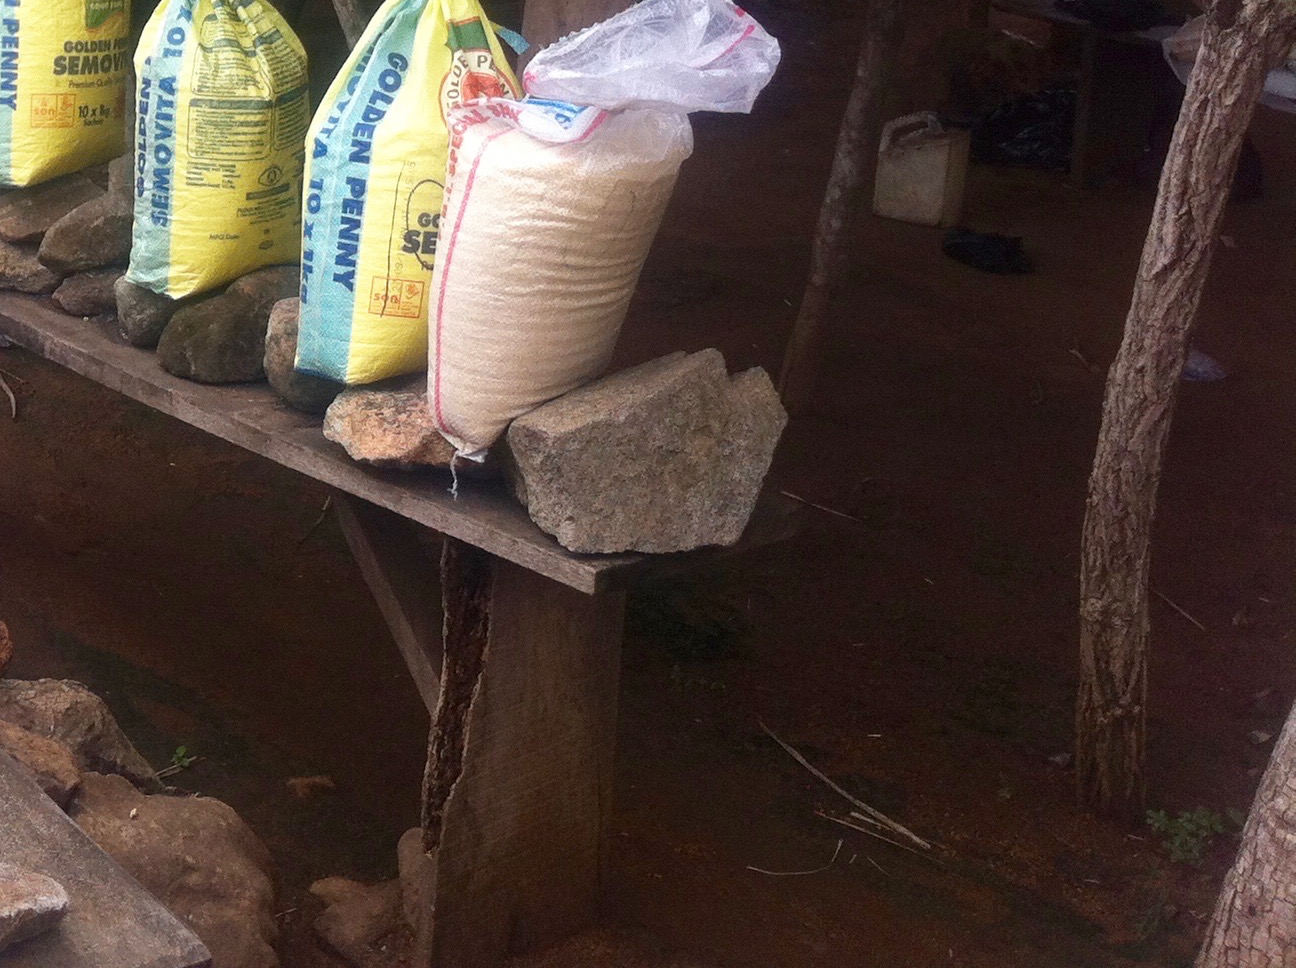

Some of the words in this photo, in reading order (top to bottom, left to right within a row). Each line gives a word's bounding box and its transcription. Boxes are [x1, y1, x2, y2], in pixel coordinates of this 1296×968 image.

[0, 18, 20, 111] PENNY
[64, 39, 111, 53] GOLDEN
[163, 26, 186, 59] 10
[137, 77, 152, 198] GOLDEN
[151, 75, 177, 227] SEMOVITA
[349, 51, 409, 164] GOLDEN
[308, 178, 324, 215] 10
[333, 176, 366, 292] PENNY
